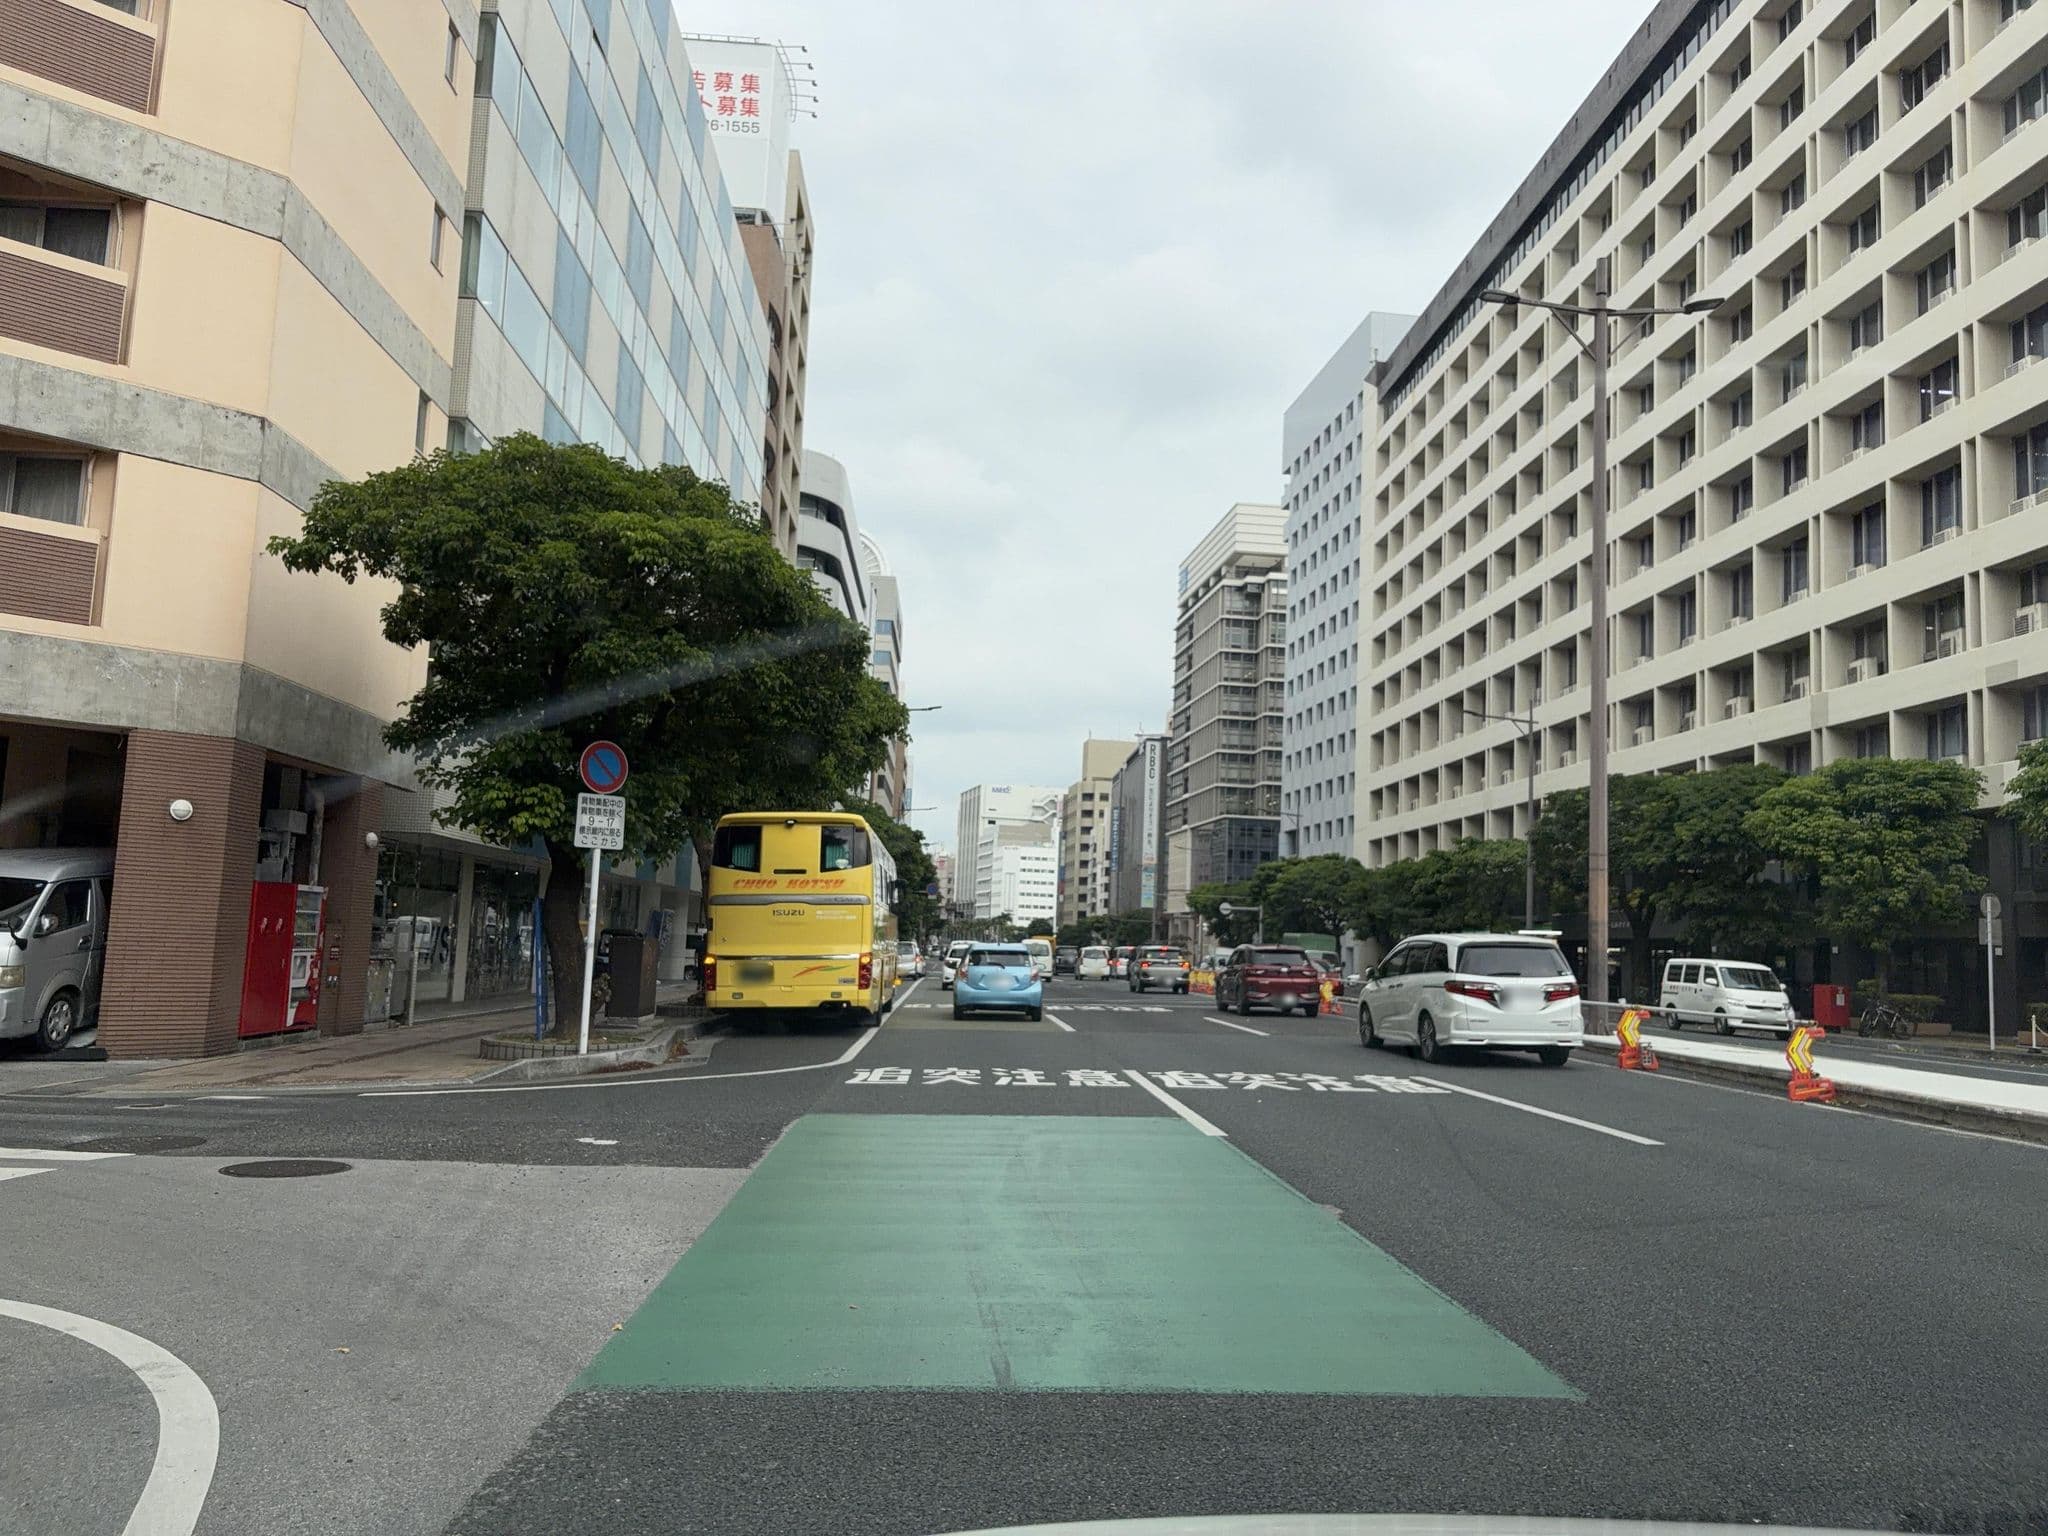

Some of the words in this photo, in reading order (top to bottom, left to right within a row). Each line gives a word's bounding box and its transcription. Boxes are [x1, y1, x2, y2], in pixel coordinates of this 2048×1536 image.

[706, 119, 760, 133] 6-1555
[845, 1066, 1132, 1087] 追突注意
[1147, 1070, 1452, 1093] 追突注意
